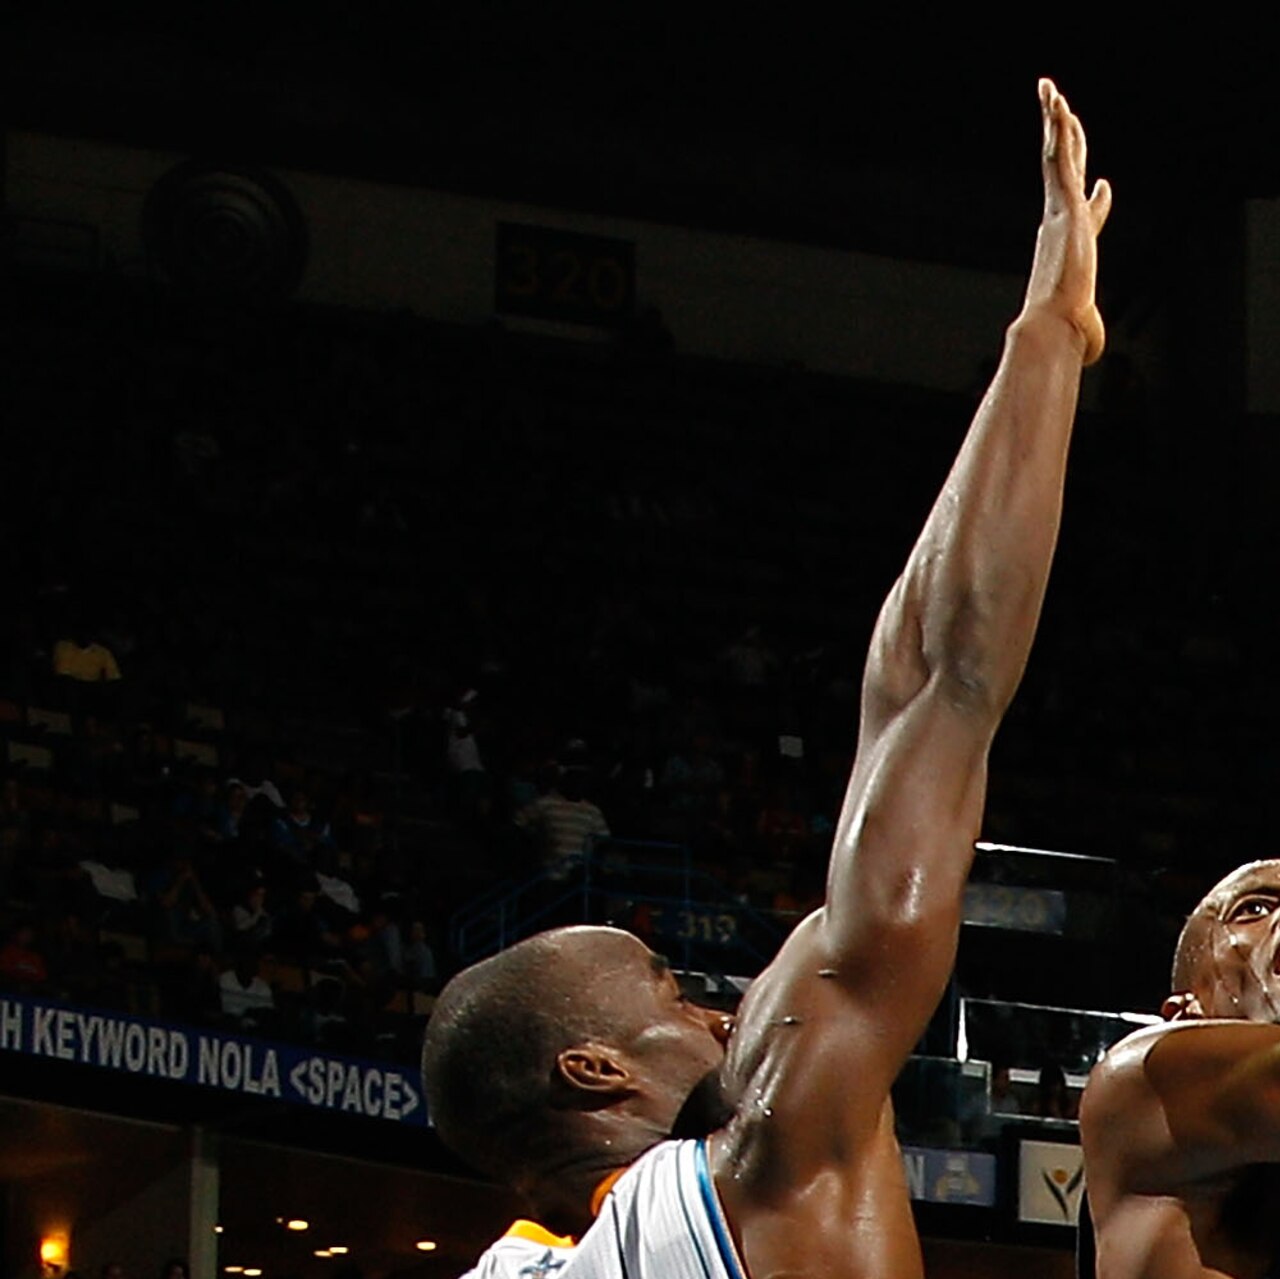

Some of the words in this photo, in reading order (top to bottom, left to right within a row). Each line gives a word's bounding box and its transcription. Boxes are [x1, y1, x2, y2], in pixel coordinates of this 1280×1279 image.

[507, 245, 627, 310] 320
[33, 1005, 190, 1080] KEYWORD
[197, 1036, 282, 1099] NOLA
[290, 1056, 420, 1122] <SPACE>
